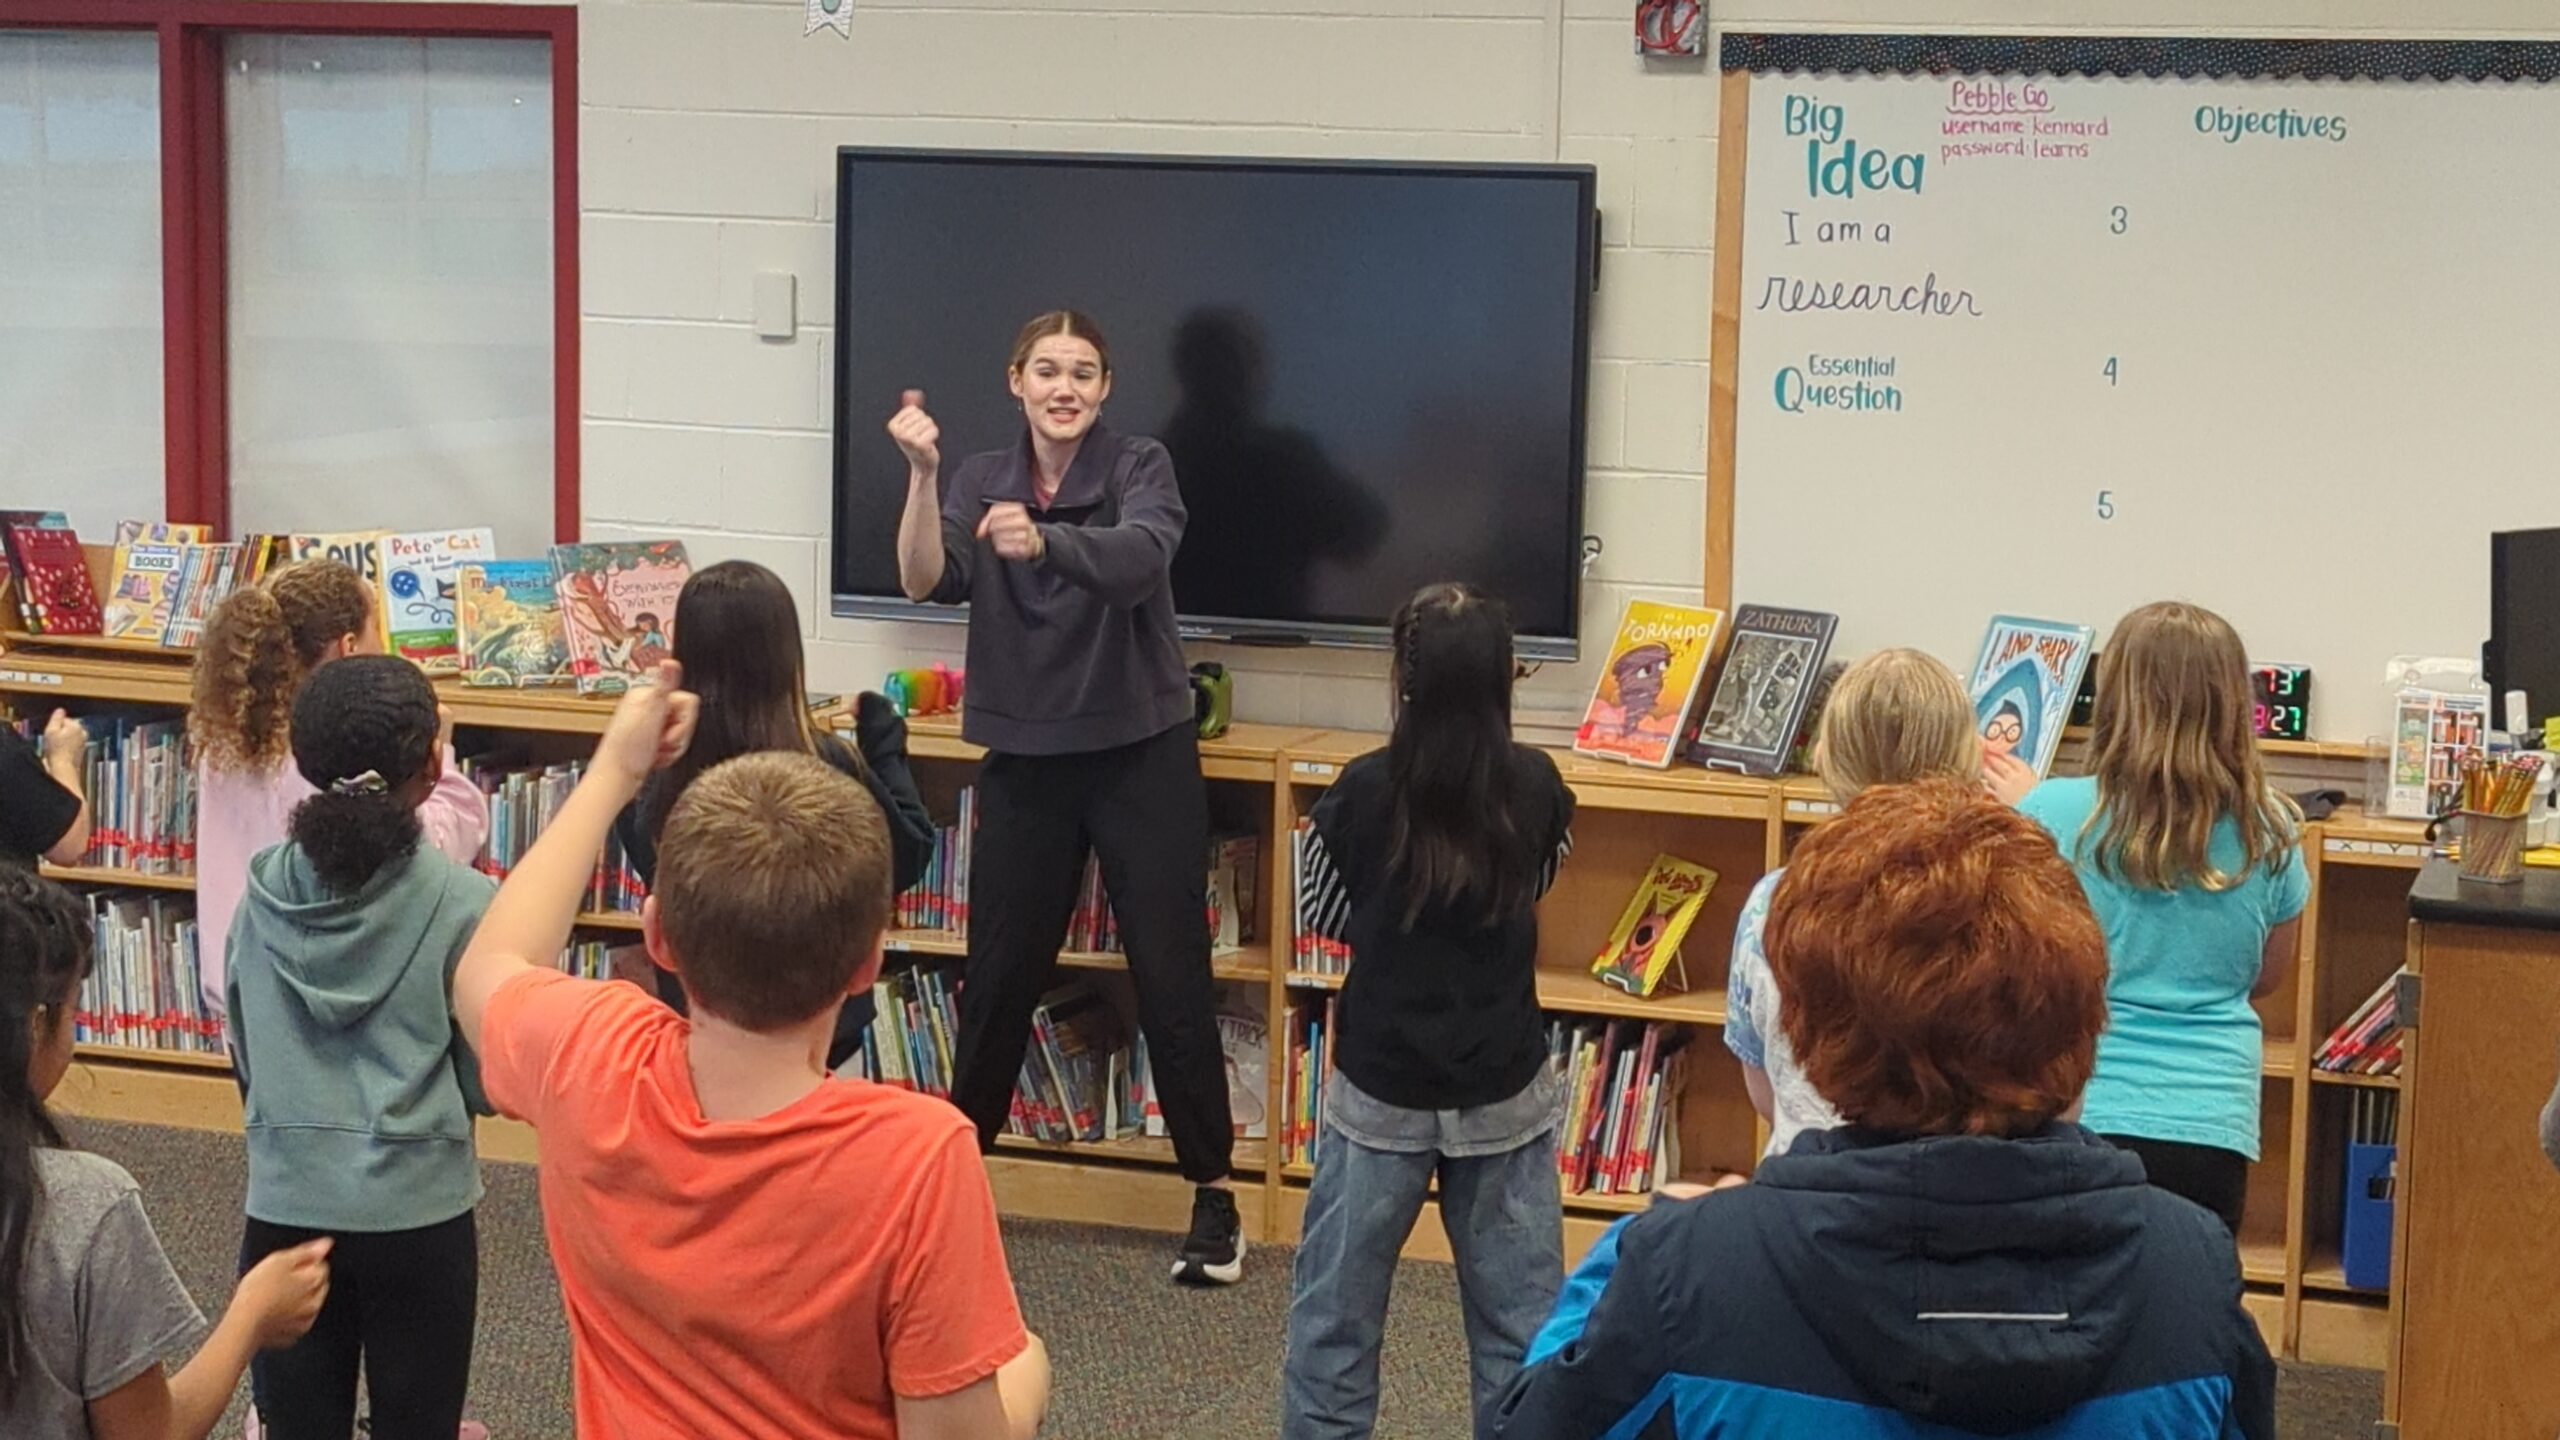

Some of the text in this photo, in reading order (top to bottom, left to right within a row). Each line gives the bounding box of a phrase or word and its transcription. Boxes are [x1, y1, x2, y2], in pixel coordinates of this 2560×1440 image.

[1951, 80, 2049, 108] Pebble Go
[1784, 94, 1844, 144] Big
[2194, 105, 2347, 144] Objectives
[2034, 138, 2089, 158] learns
[1807, 138, 1926, 199] Idea
[1781, 210, 1891, 246] I am a
[2109, 205, 2129, 235] 3
[1756, 271, 1983, 317] researcher
[1807, 353, 1896, 378] Essential
[2102, 356, 2118, 387] 4
[1773, 365, 1903, 414] Question
[2097, 489, 2115, 520] 5
[447, 533, 481, 550] Cat
[135, 555, 175, 569] BOOKS
[1623, 618, 1710, 642] TORNADO
[1741, 610, 1822, 635] ZATHURA
